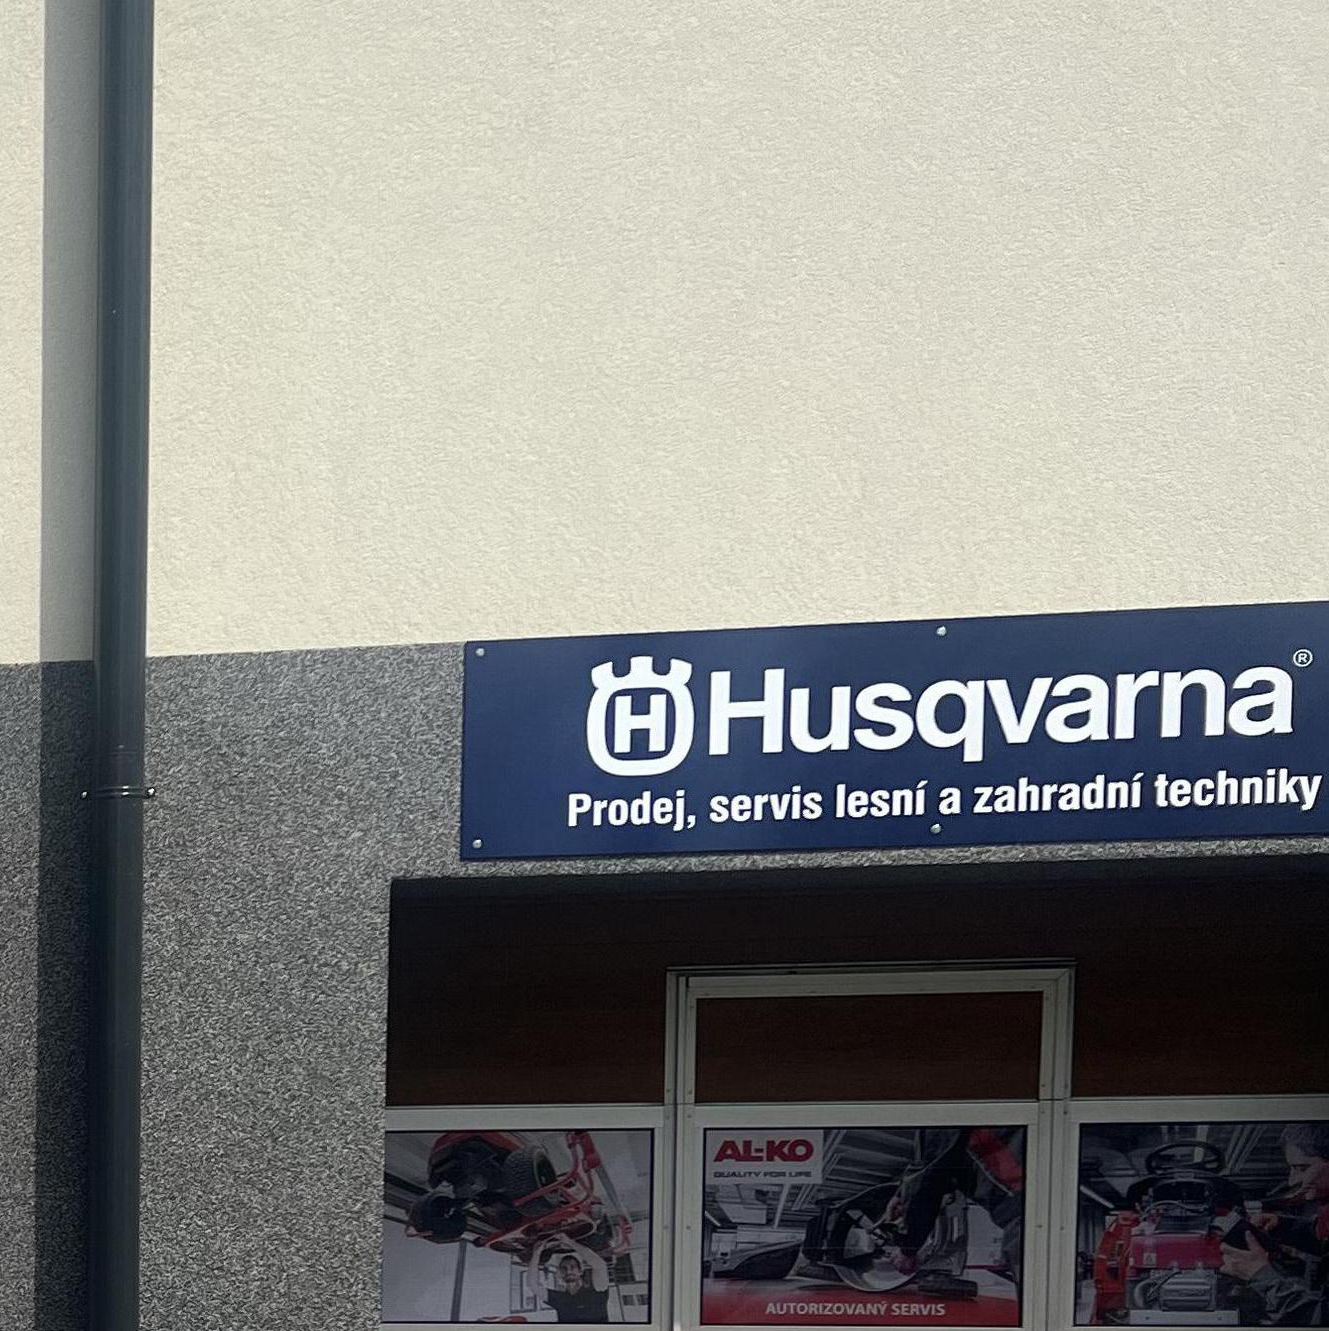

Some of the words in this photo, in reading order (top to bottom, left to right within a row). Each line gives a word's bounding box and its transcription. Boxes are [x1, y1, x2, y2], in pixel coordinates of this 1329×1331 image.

[708, 666, 1294, 762] Husqvarna
[567, 789, 697, 833] Prodej,
[709, 785, 823, 823] servis
[835, 780, 929, 818] lesní
[938, 784, 962, 815] a
[972, 772, 1145, 814] zahradní
[1154, 768, 1323, 812] techniky
[714, 1140, 814, 1162] AL-KO
[765, 1301, 888, 1316] AUTORIZOVANÝ
[891, 1303, 946, 1316] SERVIS
